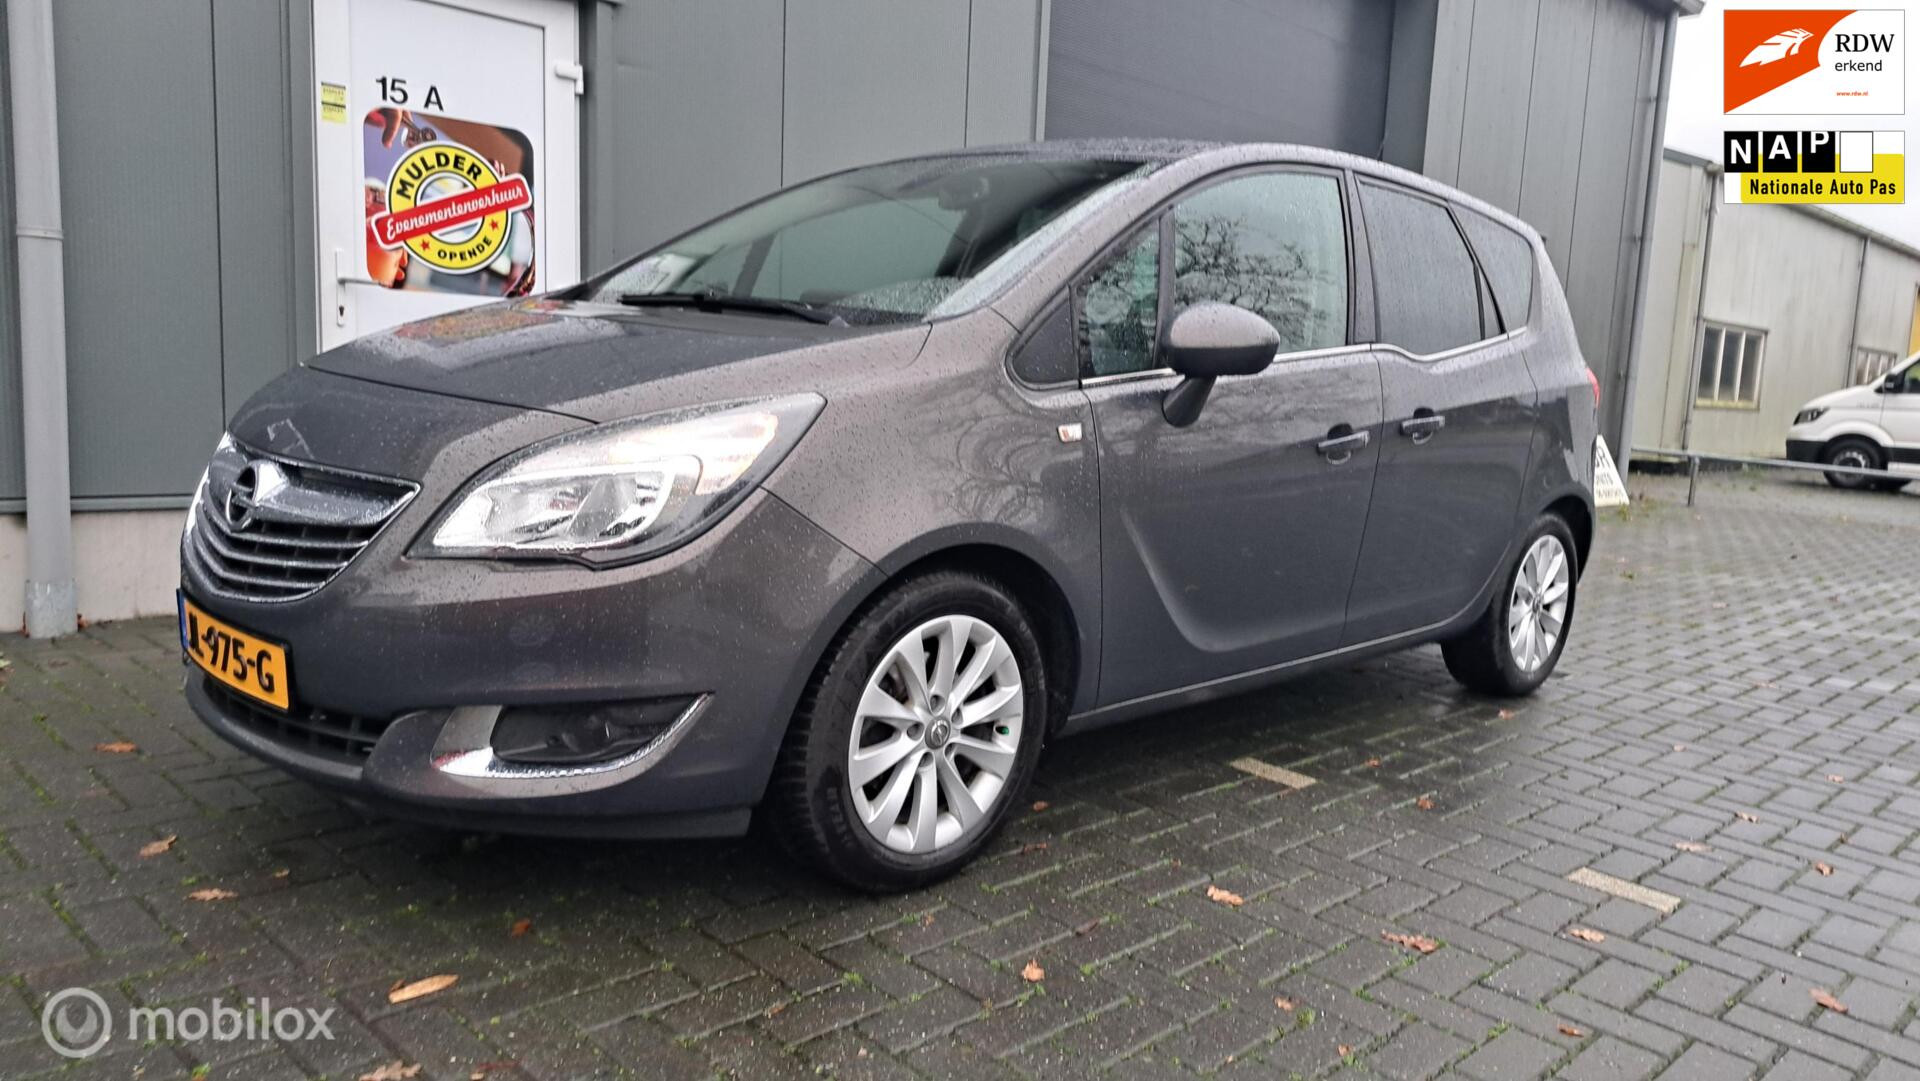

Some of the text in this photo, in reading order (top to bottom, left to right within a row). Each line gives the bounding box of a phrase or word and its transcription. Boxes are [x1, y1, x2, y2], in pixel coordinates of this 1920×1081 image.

[375, 76, 445, 112] 15 A
[396, 151, 484, 201] MULDER
[386, 184, 525, 241] Evenementenverhuur
[437, 235, 493, 262] OPENDE
